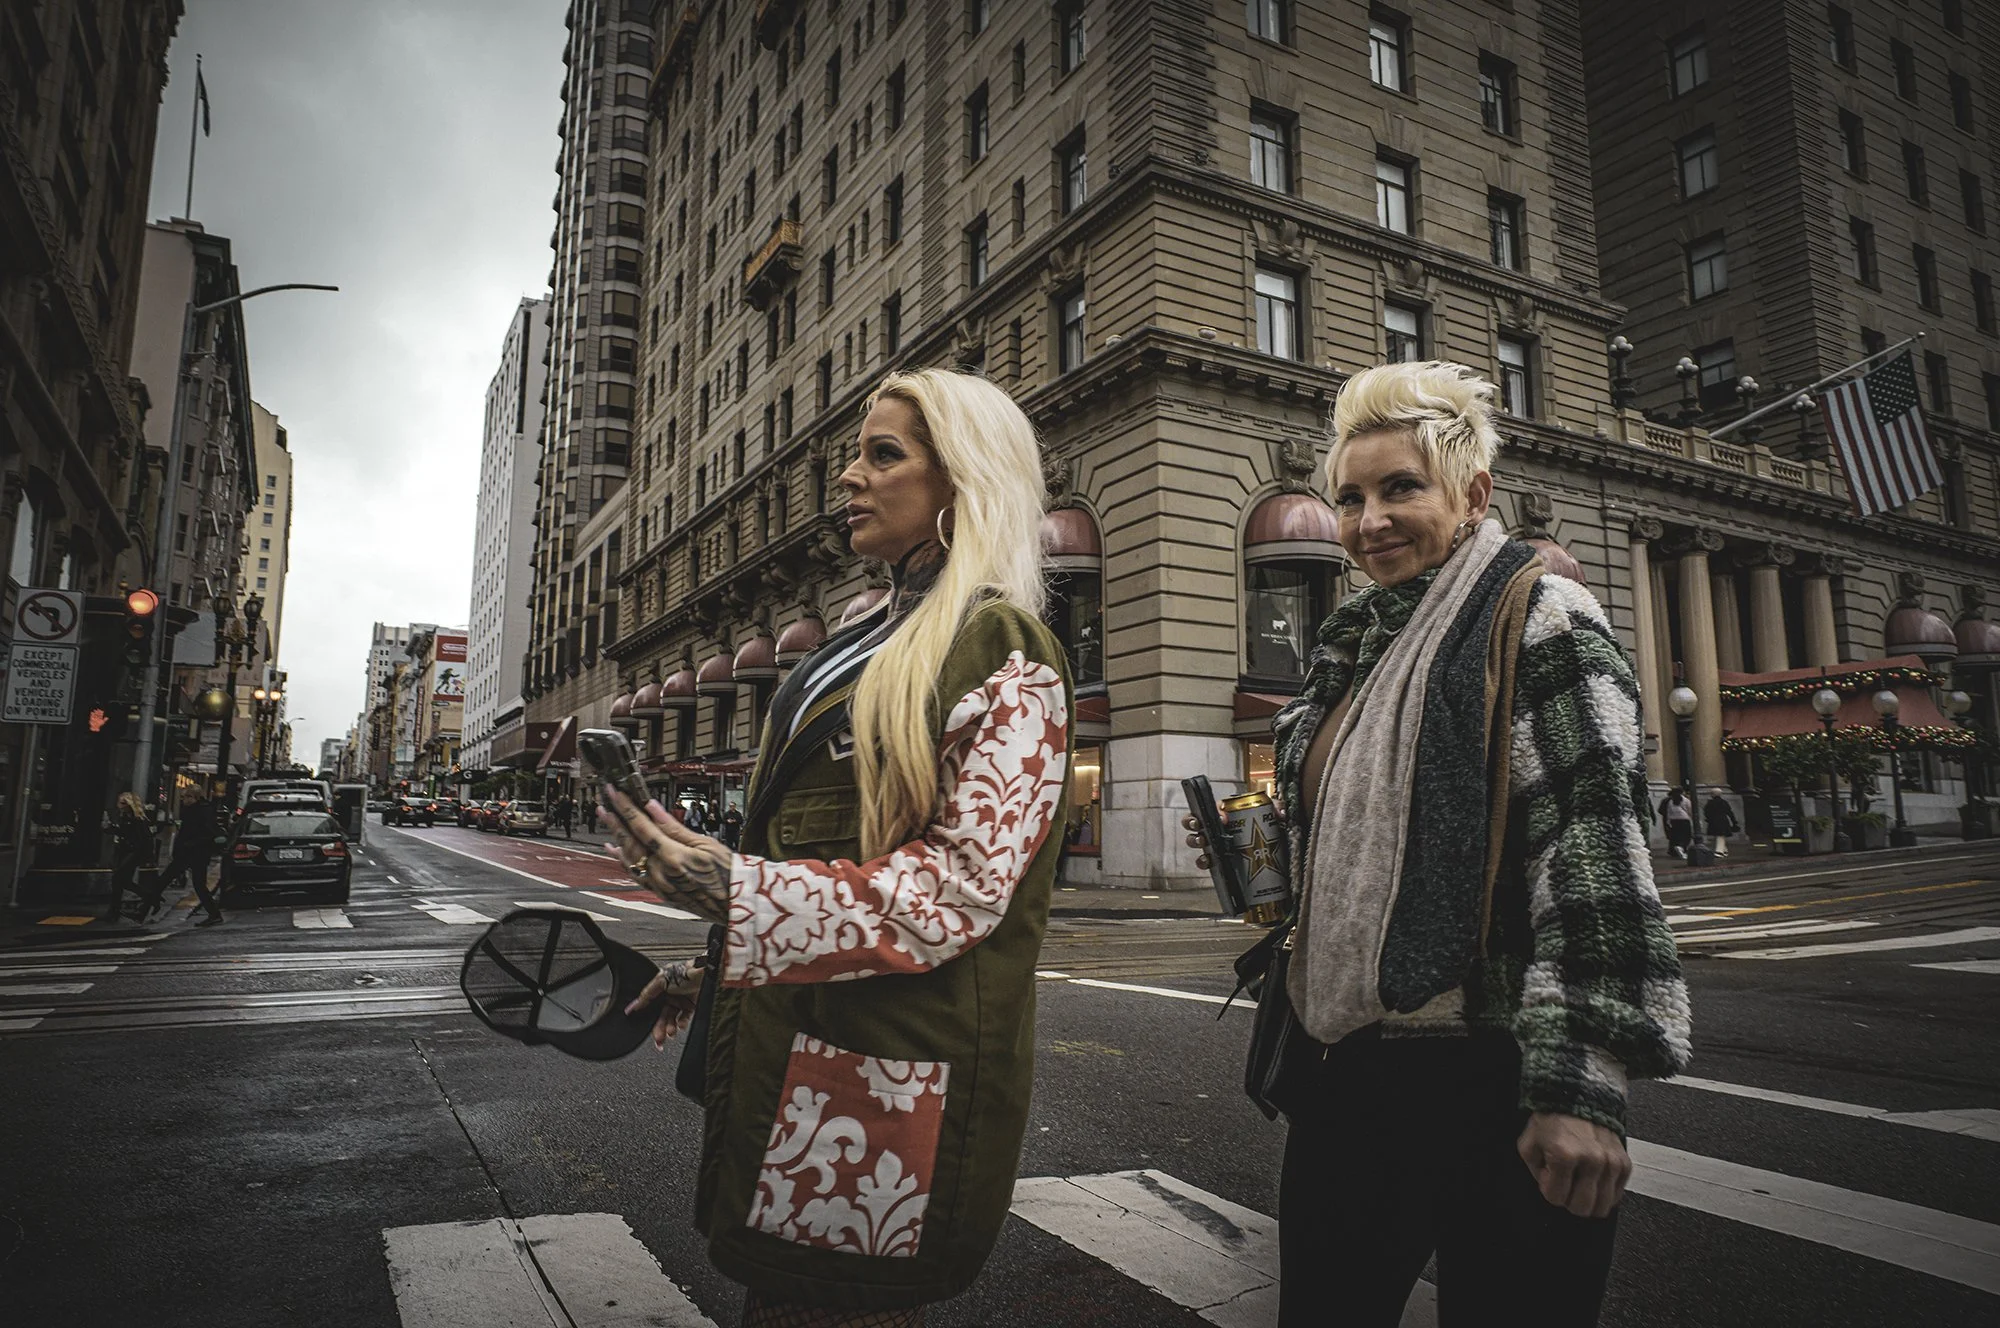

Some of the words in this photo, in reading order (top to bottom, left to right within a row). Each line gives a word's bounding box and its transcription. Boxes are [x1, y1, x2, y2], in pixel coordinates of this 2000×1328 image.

[23, 650, 63, 660] EXCEPT
[12, 658, 72, 671] COMMERCIAL
[16, 668, 67, 680] VEHICLES
[30, 679, 51, 688] AND
[14, 687, 65, 699] VEHICLES
[14, 697, 61, 708] LOADING
[6, 705, 21, 715] ON
[25, 706, 66, 718] POWELL
